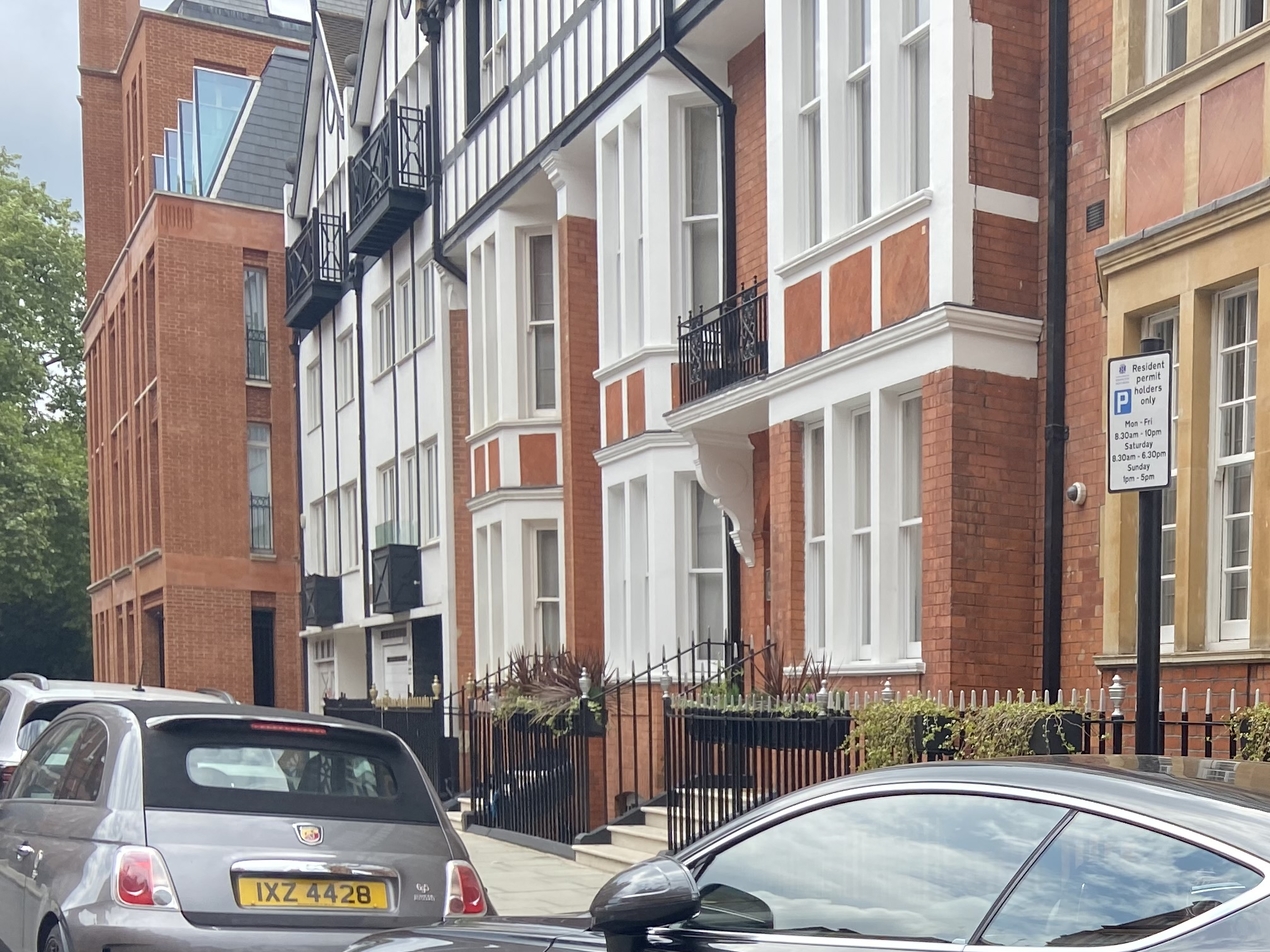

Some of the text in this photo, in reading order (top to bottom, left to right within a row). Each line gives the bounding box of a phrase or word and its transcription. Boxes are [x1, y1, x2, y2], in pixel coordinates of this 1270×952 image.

[1132, 360, 1165, 373] Resident
[1136, 371, 1161, 385] permit
[1134, 384, 1163, 395] holders
[1117, 391, 1129, 413] P
[1140, 395, 1156, 406] only
[1124, 420, 1139, 428] Mon
[1143, 417, 1153, 426] Fri
[1114, 431, 1139, 440] 8.30am
[1144, 428, 1162, 438] 10pm
[1124, 440, 1154, 450] Saturday
[1111, 453, 1136, 463] 8.30am
[1141, 450, 1167, 460] 6.30pm
[1127, 462, 1151, 472] Sunday
[1122, 475, 1135, 484] 1pm
[1140, 473, 1155, 482] 5pm
[256, 882, 372, 905] IXZ 4428
